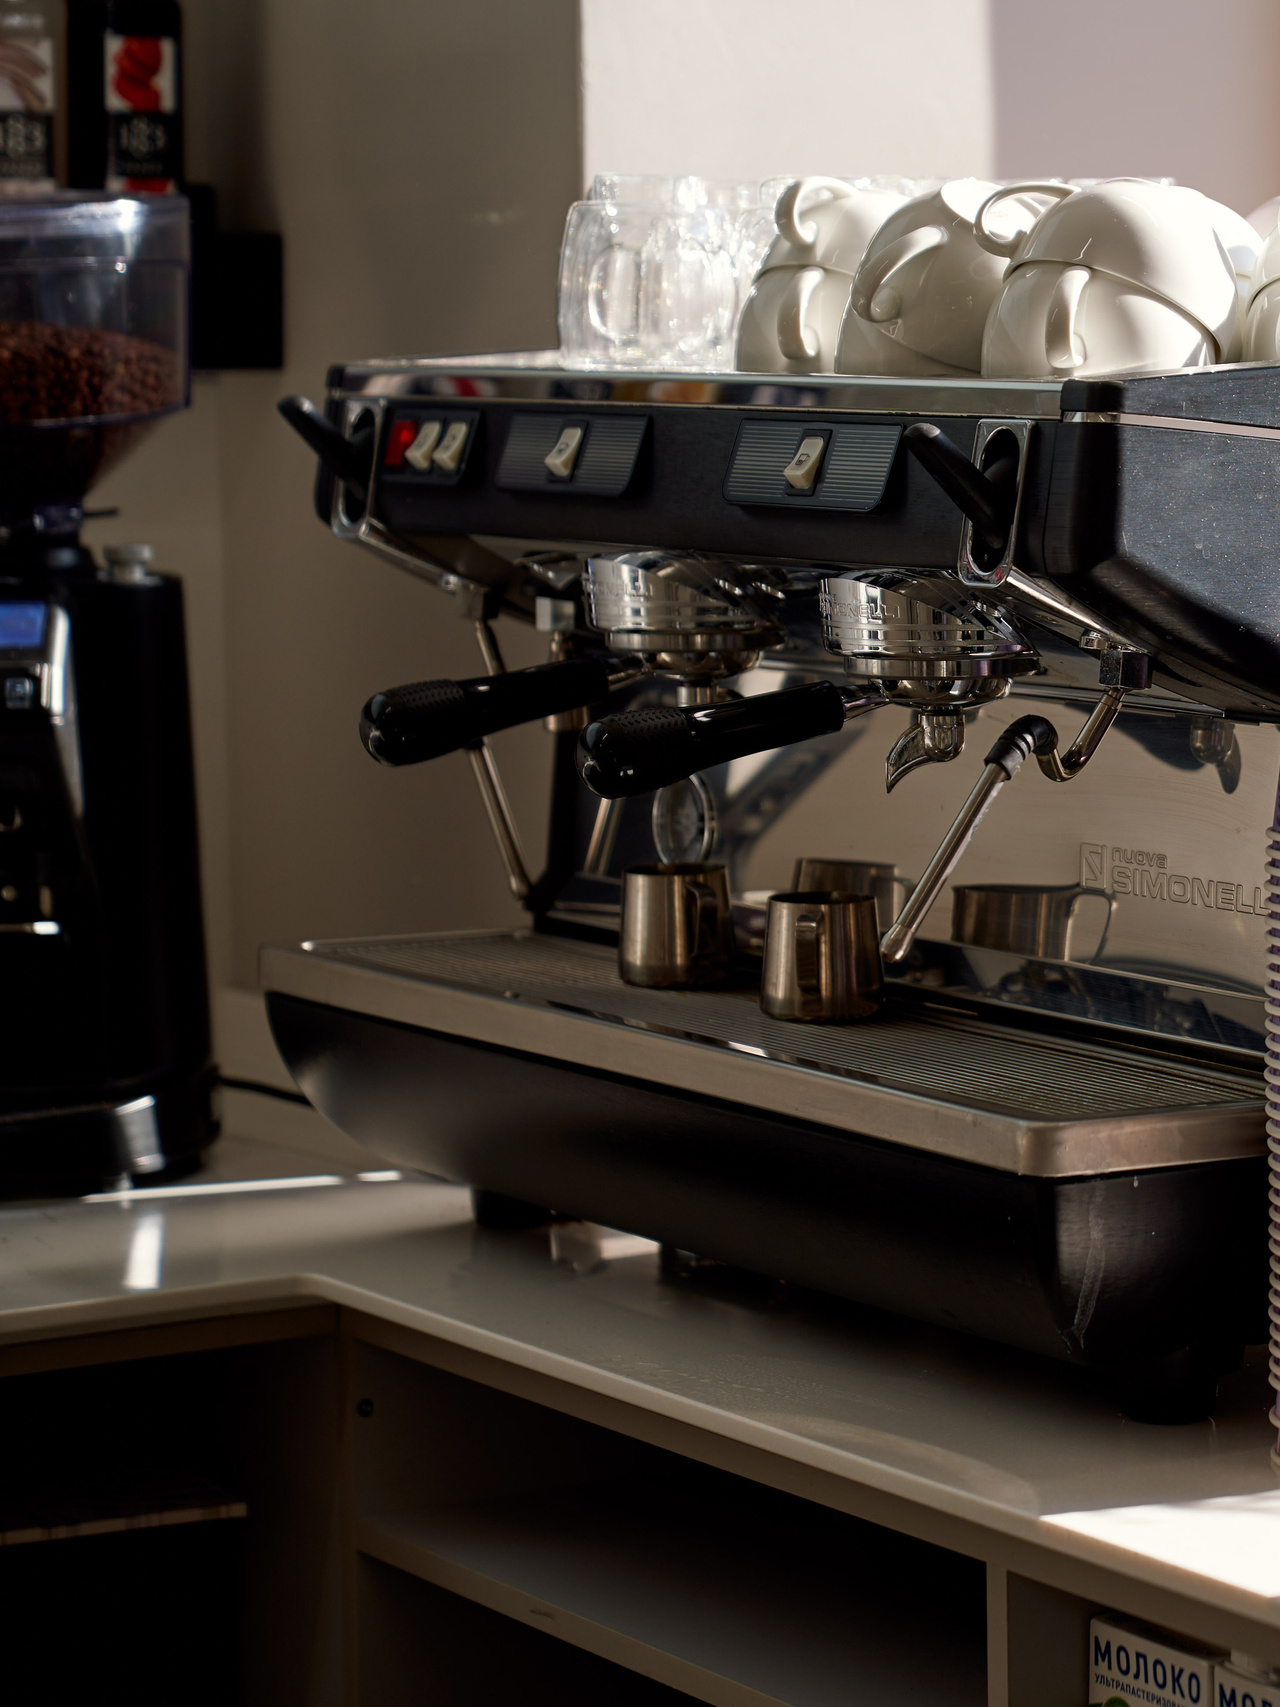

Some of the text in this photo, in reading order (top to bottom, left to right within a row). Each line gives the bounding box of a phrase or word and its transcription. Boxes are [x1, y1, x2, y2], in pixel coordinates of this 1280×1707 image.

[1112, 847, 1168, 869] nuova
[1112, 865, 1272, 917] SIMONELL
[1094, 1635, 1201, 1704] МОЛОКО
[1095, 1673, 1187, 1707] УЛЬТРАПАСТЕРИЗОВ
